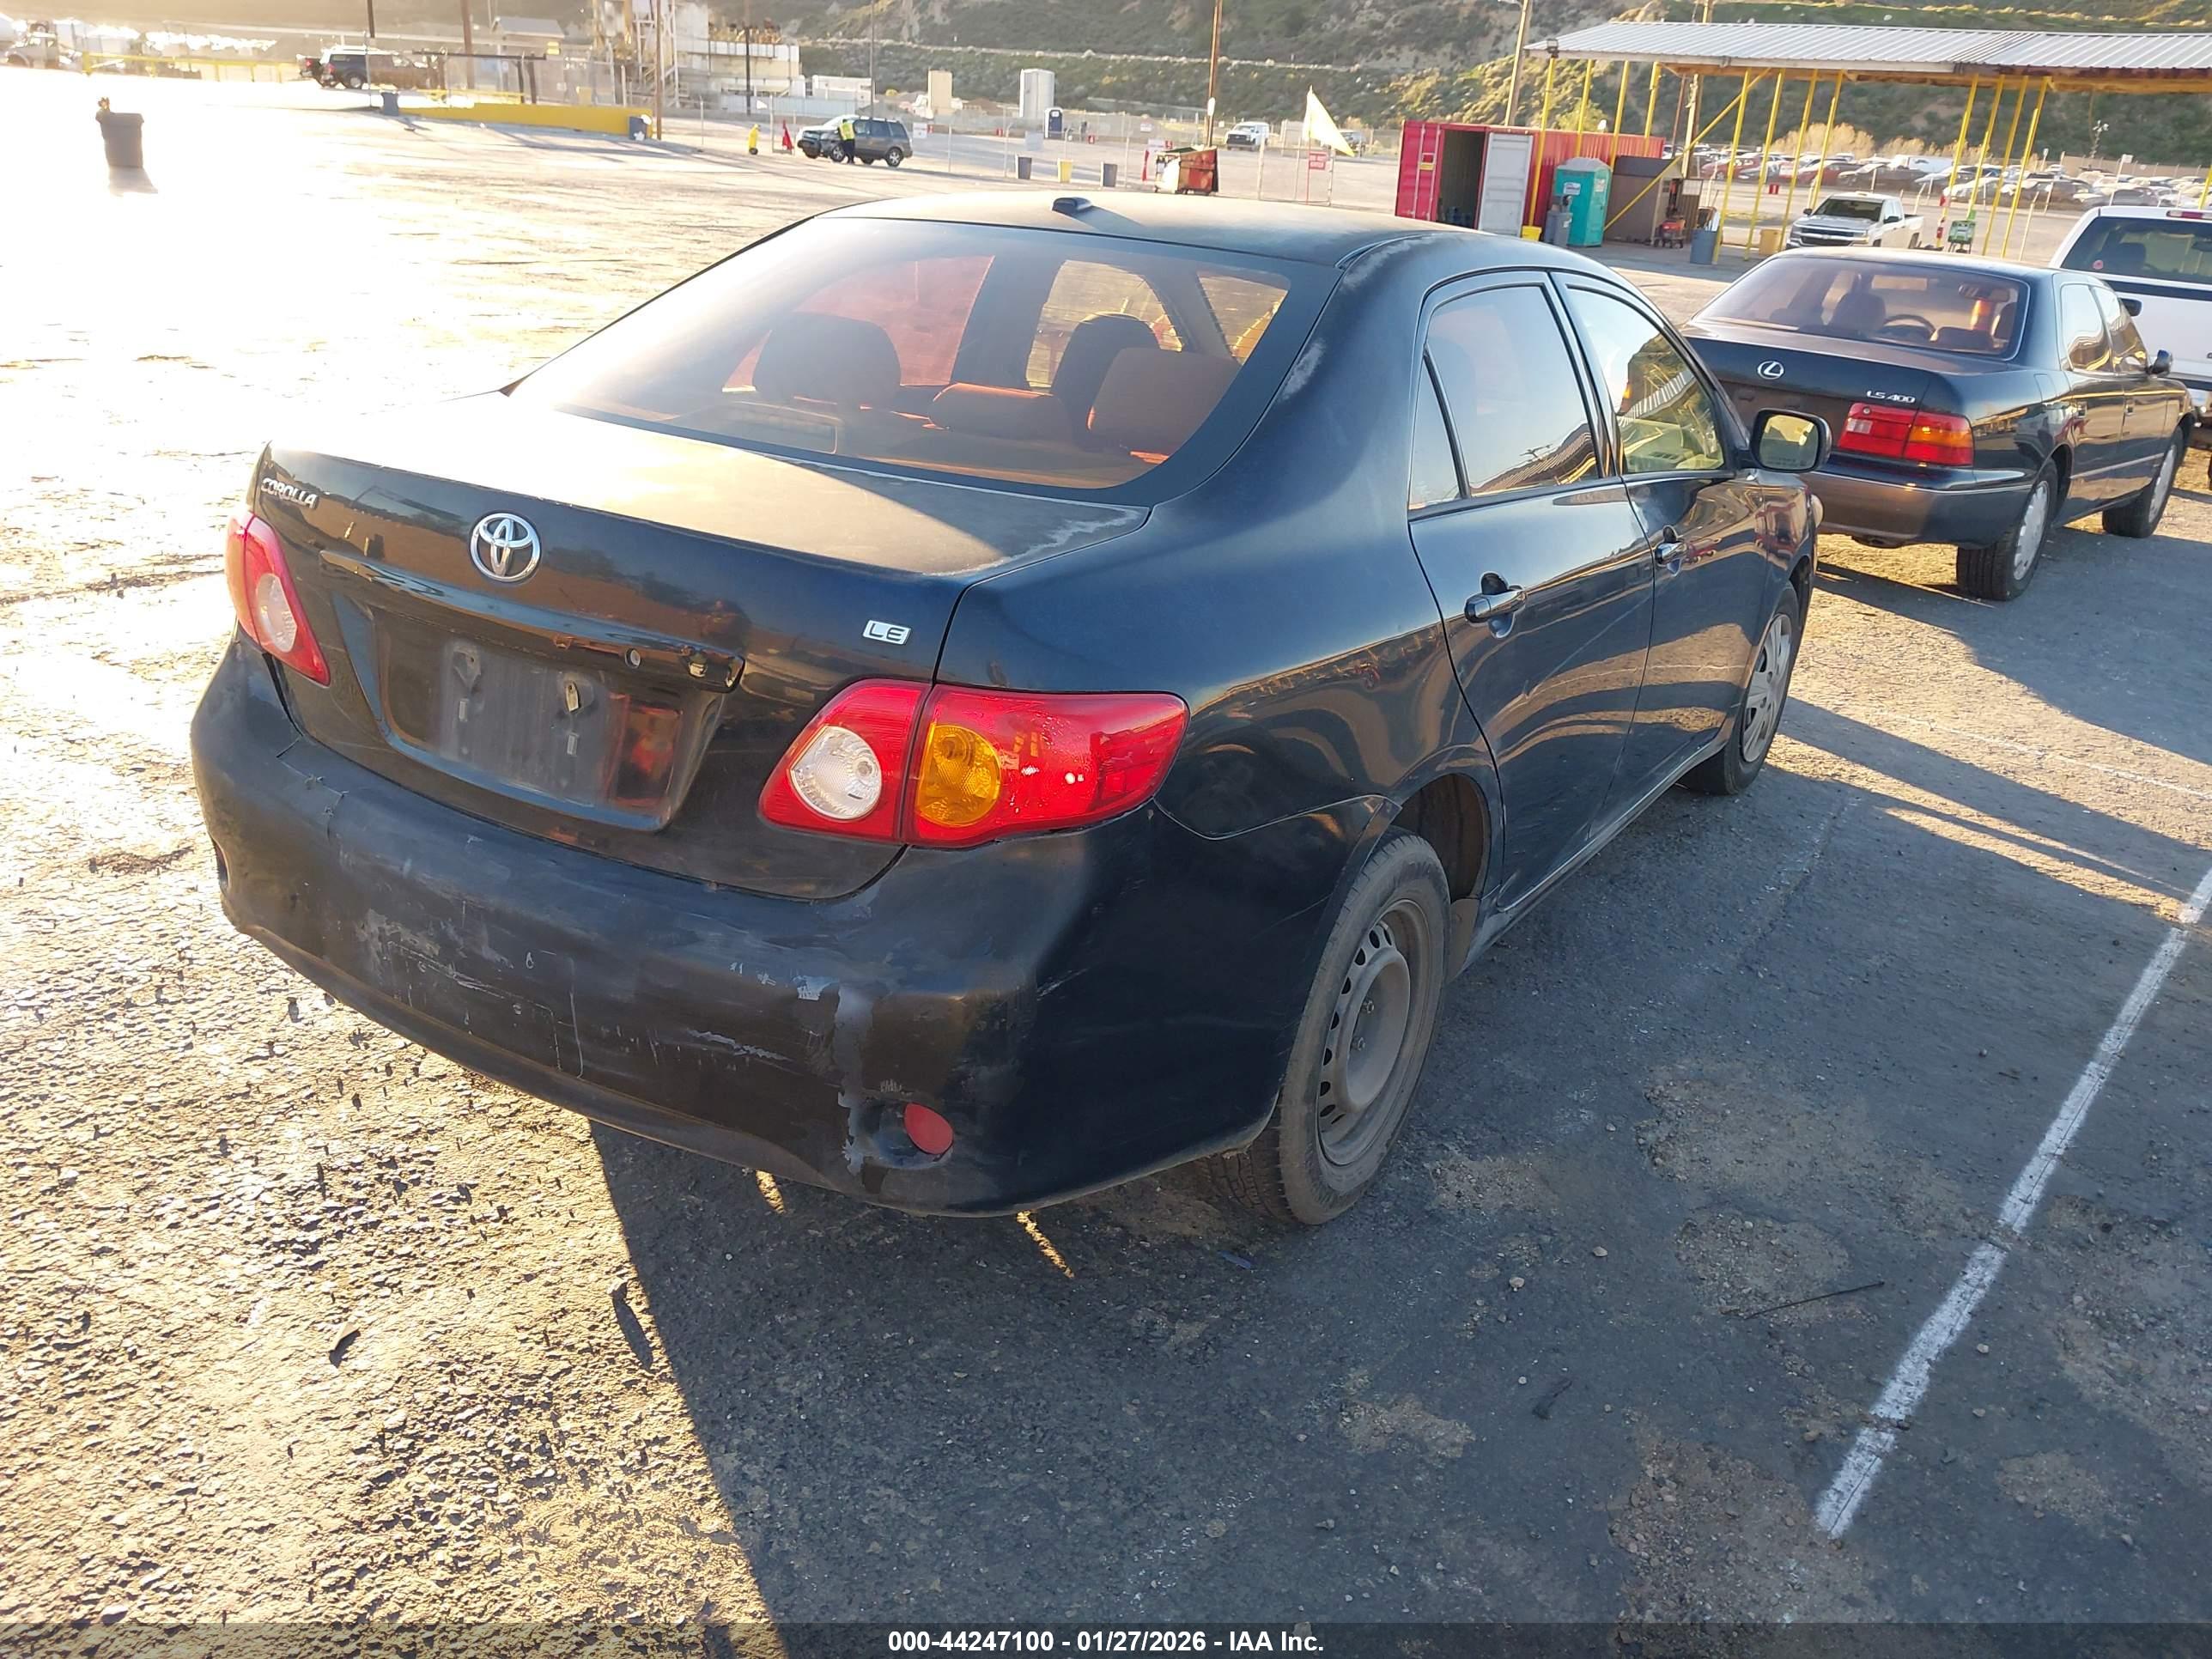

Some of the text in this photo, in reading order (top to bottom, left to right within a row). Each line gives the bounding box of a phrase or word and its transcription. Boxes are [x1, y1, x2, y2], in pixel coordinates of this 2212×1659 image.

[1866, 390, 1916, 404] LS 400
[260, 477, 318, 508] COROLLA
[867, 622, 908, 643] LE
